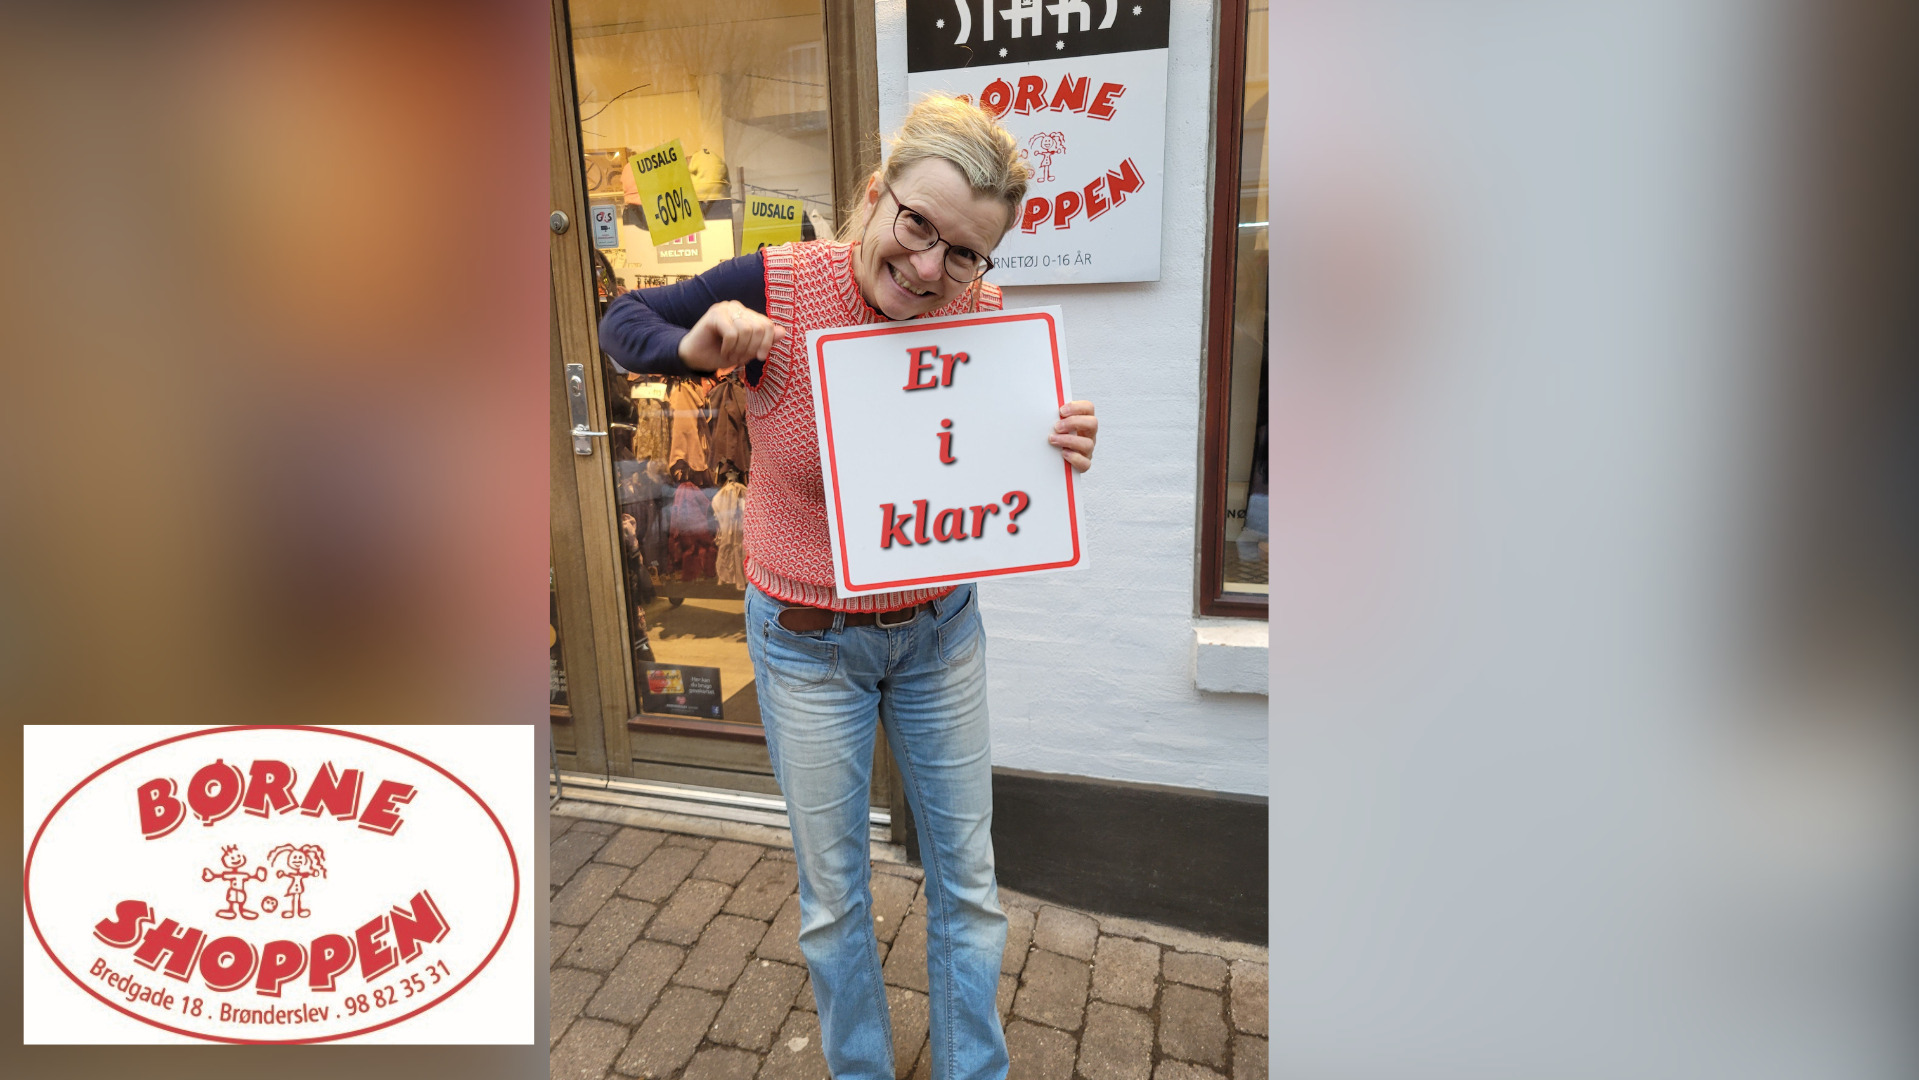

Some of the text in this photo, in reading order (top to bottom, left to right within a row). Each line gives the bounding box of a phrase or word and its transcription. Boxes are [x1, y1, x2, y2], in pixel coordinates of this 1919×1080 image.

[956, 72, 1127, 122] ØRNE
[637, 147, 677, 174] UDSALG
[655, 187, 692, 226] -60%
[753, 202, 795, 221] UDSALG
[660, 249, 698, 258] MELTON
[1042, 254, 1070, 267] 0-16
[1074, 250, 1092, 266] ÅR
[902, 345, 969, 391] Er
[936, 418, 957, 464] i
[879, 490, 1029, 549] klar?
